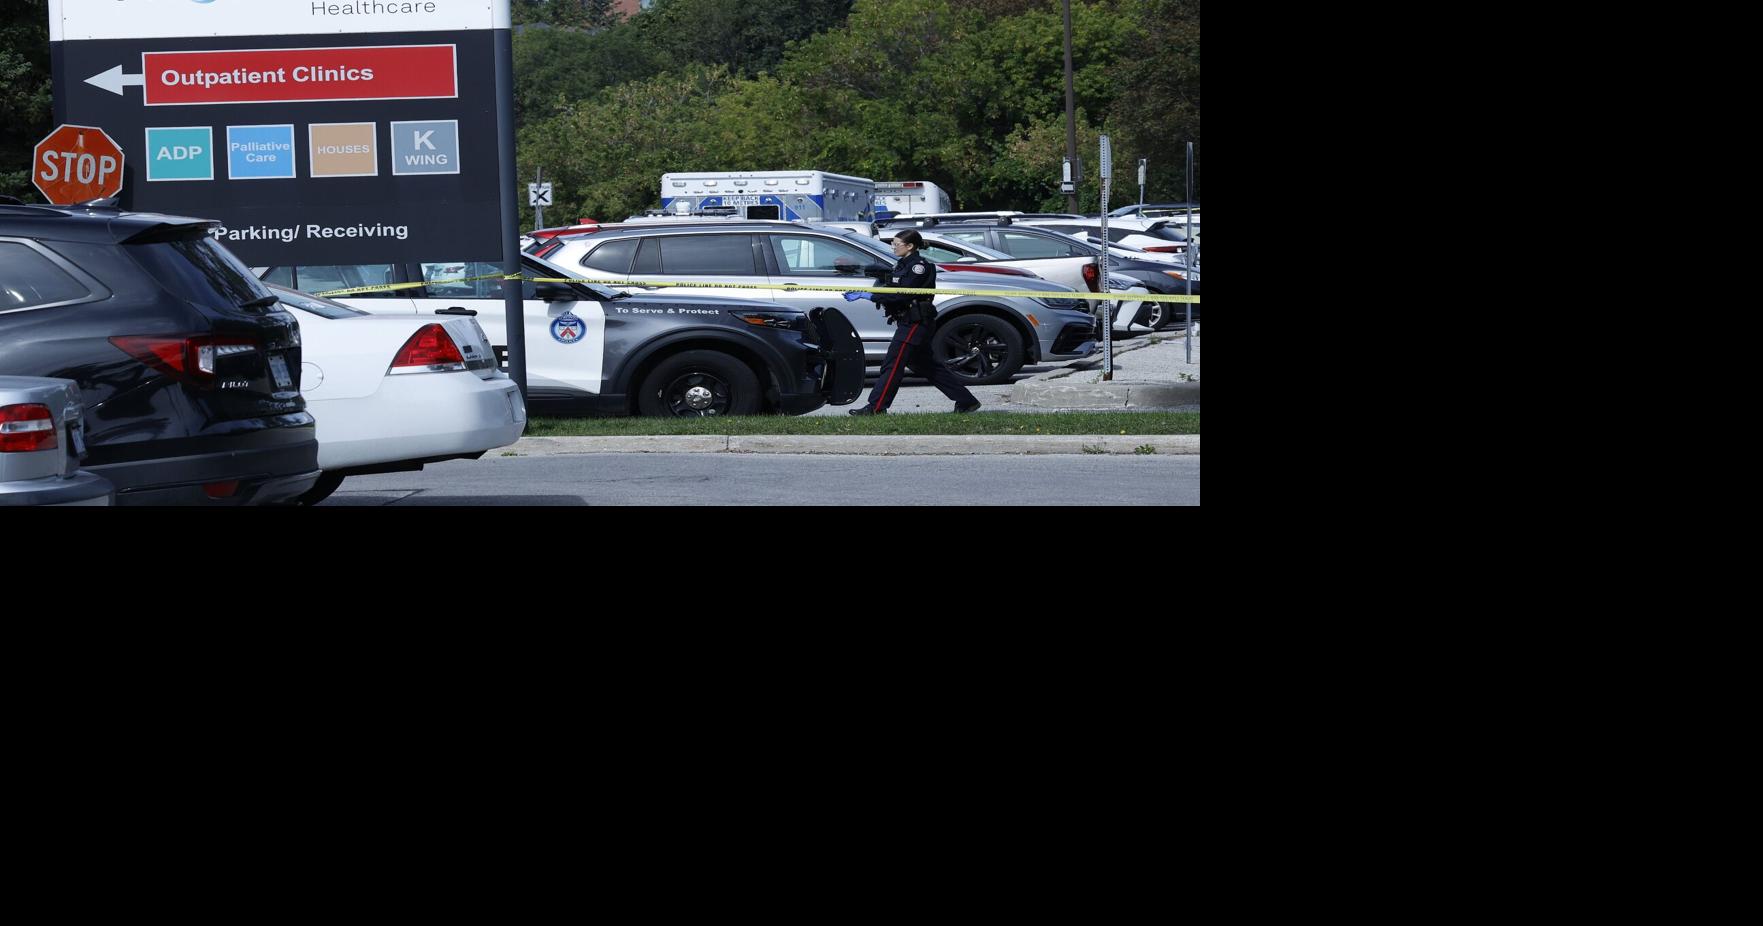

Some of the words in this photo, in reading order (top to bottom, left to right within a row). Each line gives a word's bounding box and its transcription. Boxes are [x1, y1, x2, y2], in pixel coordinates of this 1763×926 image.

[311, 0, 436, 16] Healthcare
[161, 67, 286, 89] Outpatient
[292, 65, 374, 83] Clinics
[231, 141, 290, 153] Palliative
[413, 130, 436, 151] K
[156, 146, 203, 161] ADP
[317, 144, 370, 155] HOUSES
[245, 152, 277, 163] Care
[405, 154, 448, 166] WING
[40, 150, 117, 185] STOP
[214, 225, 300, 243] Parking/
[306, 223, 409, 240] Receiving
